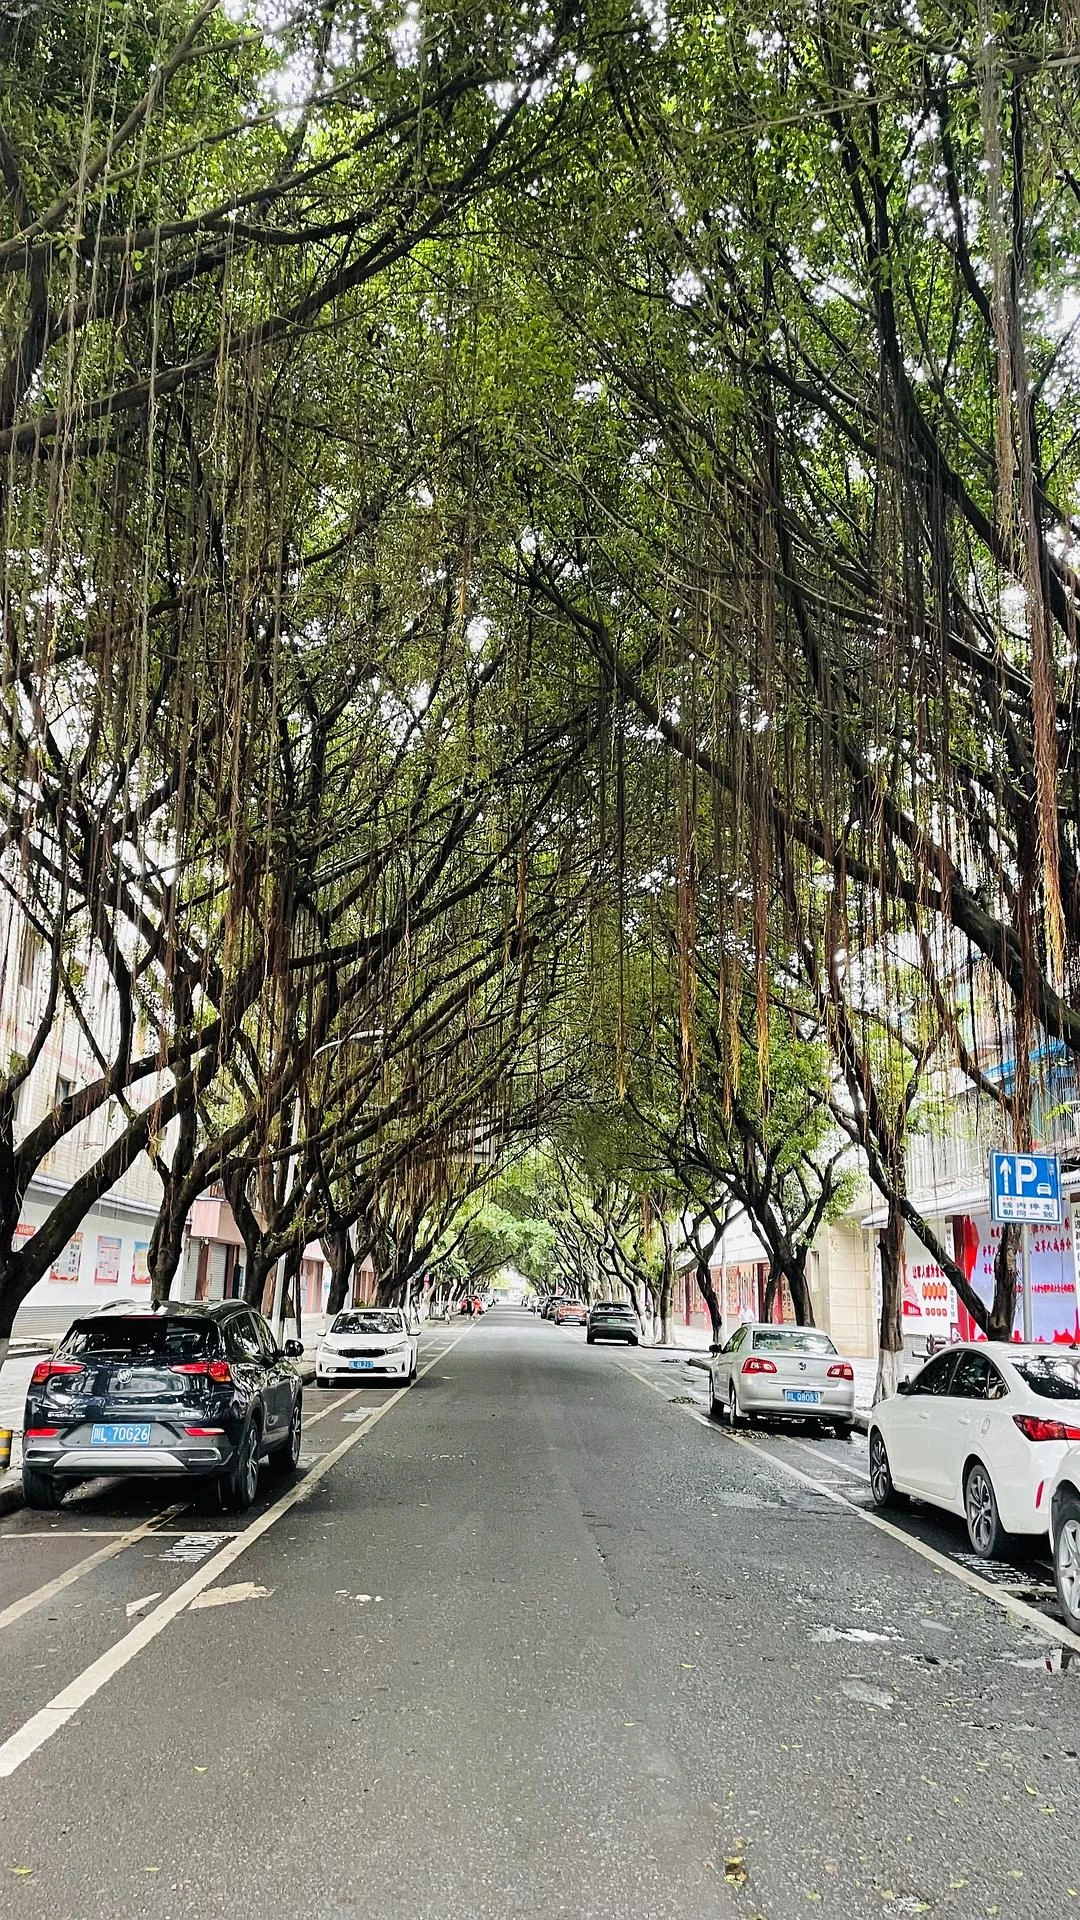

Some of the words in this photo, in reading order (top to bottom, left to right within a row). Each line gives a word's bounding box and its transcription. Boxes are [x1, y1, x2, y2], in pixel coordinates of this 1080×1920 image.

[1015, 1158, 1037, 1195] P
[1003, 1209, 1054, 1218] 朝向一致
[112, 1427, 148, 1441] 70G26
